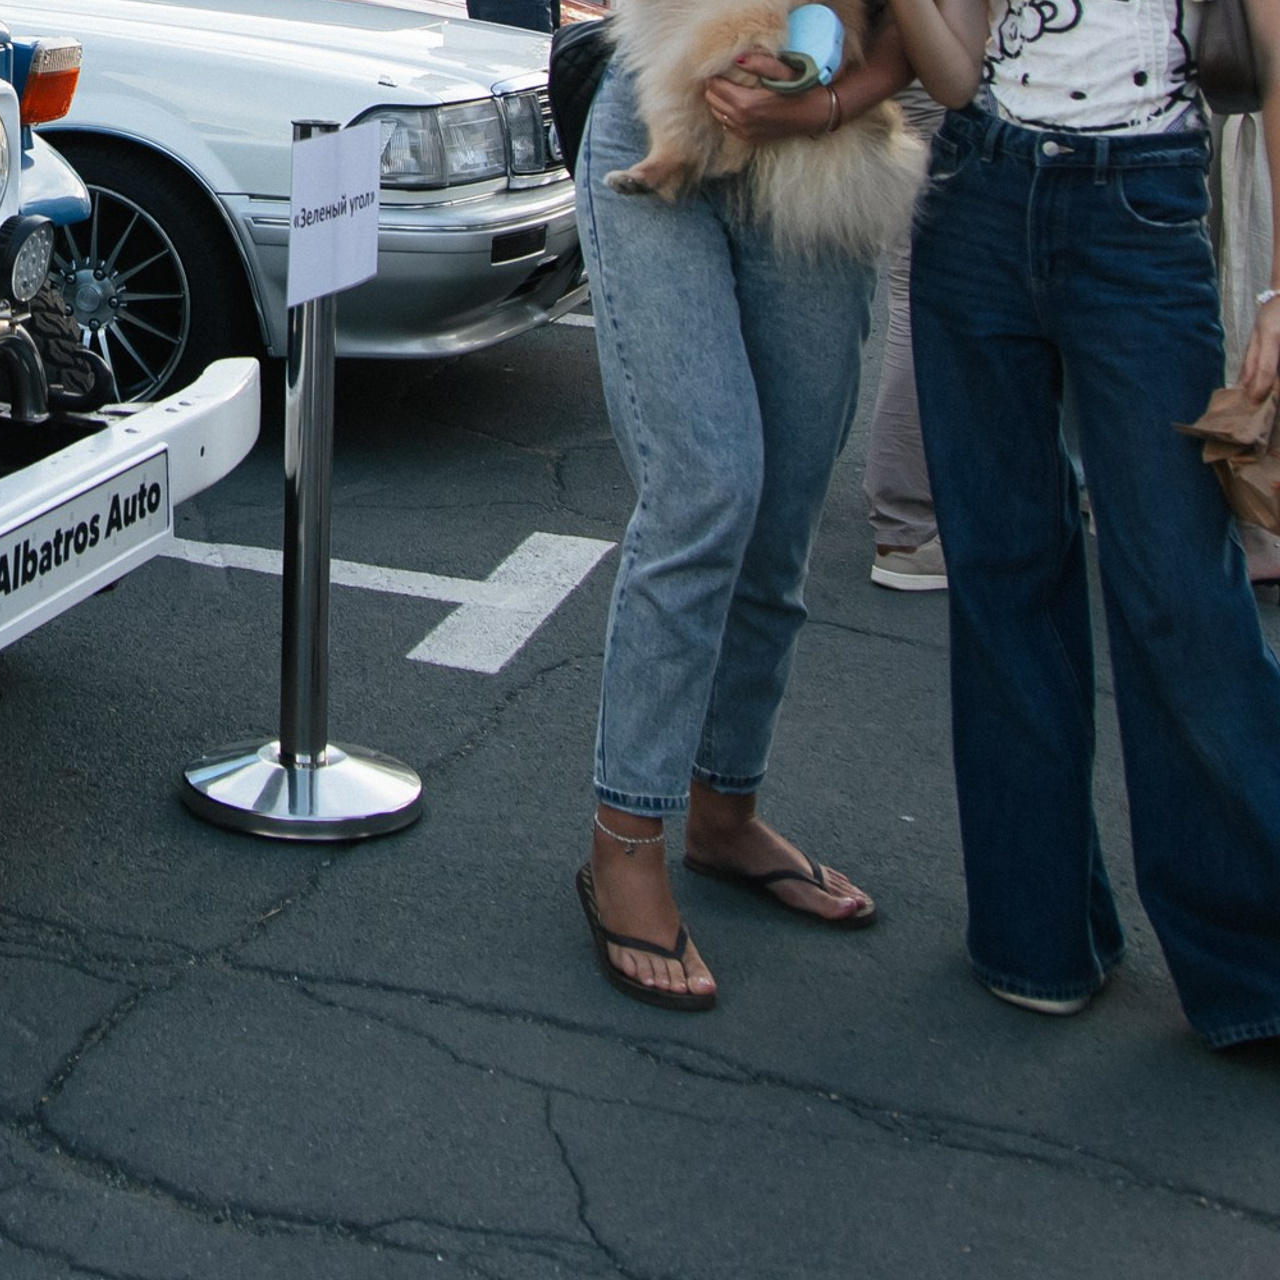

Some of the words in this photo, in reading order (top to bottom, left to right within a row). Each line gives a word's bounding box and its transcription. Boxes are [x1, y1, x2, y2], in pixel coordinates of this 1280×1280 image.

[293, 193, 347, 229] «Зеленый
[349, 190, 376, 217] угол»
[104, 481, 162, 539] Auto
